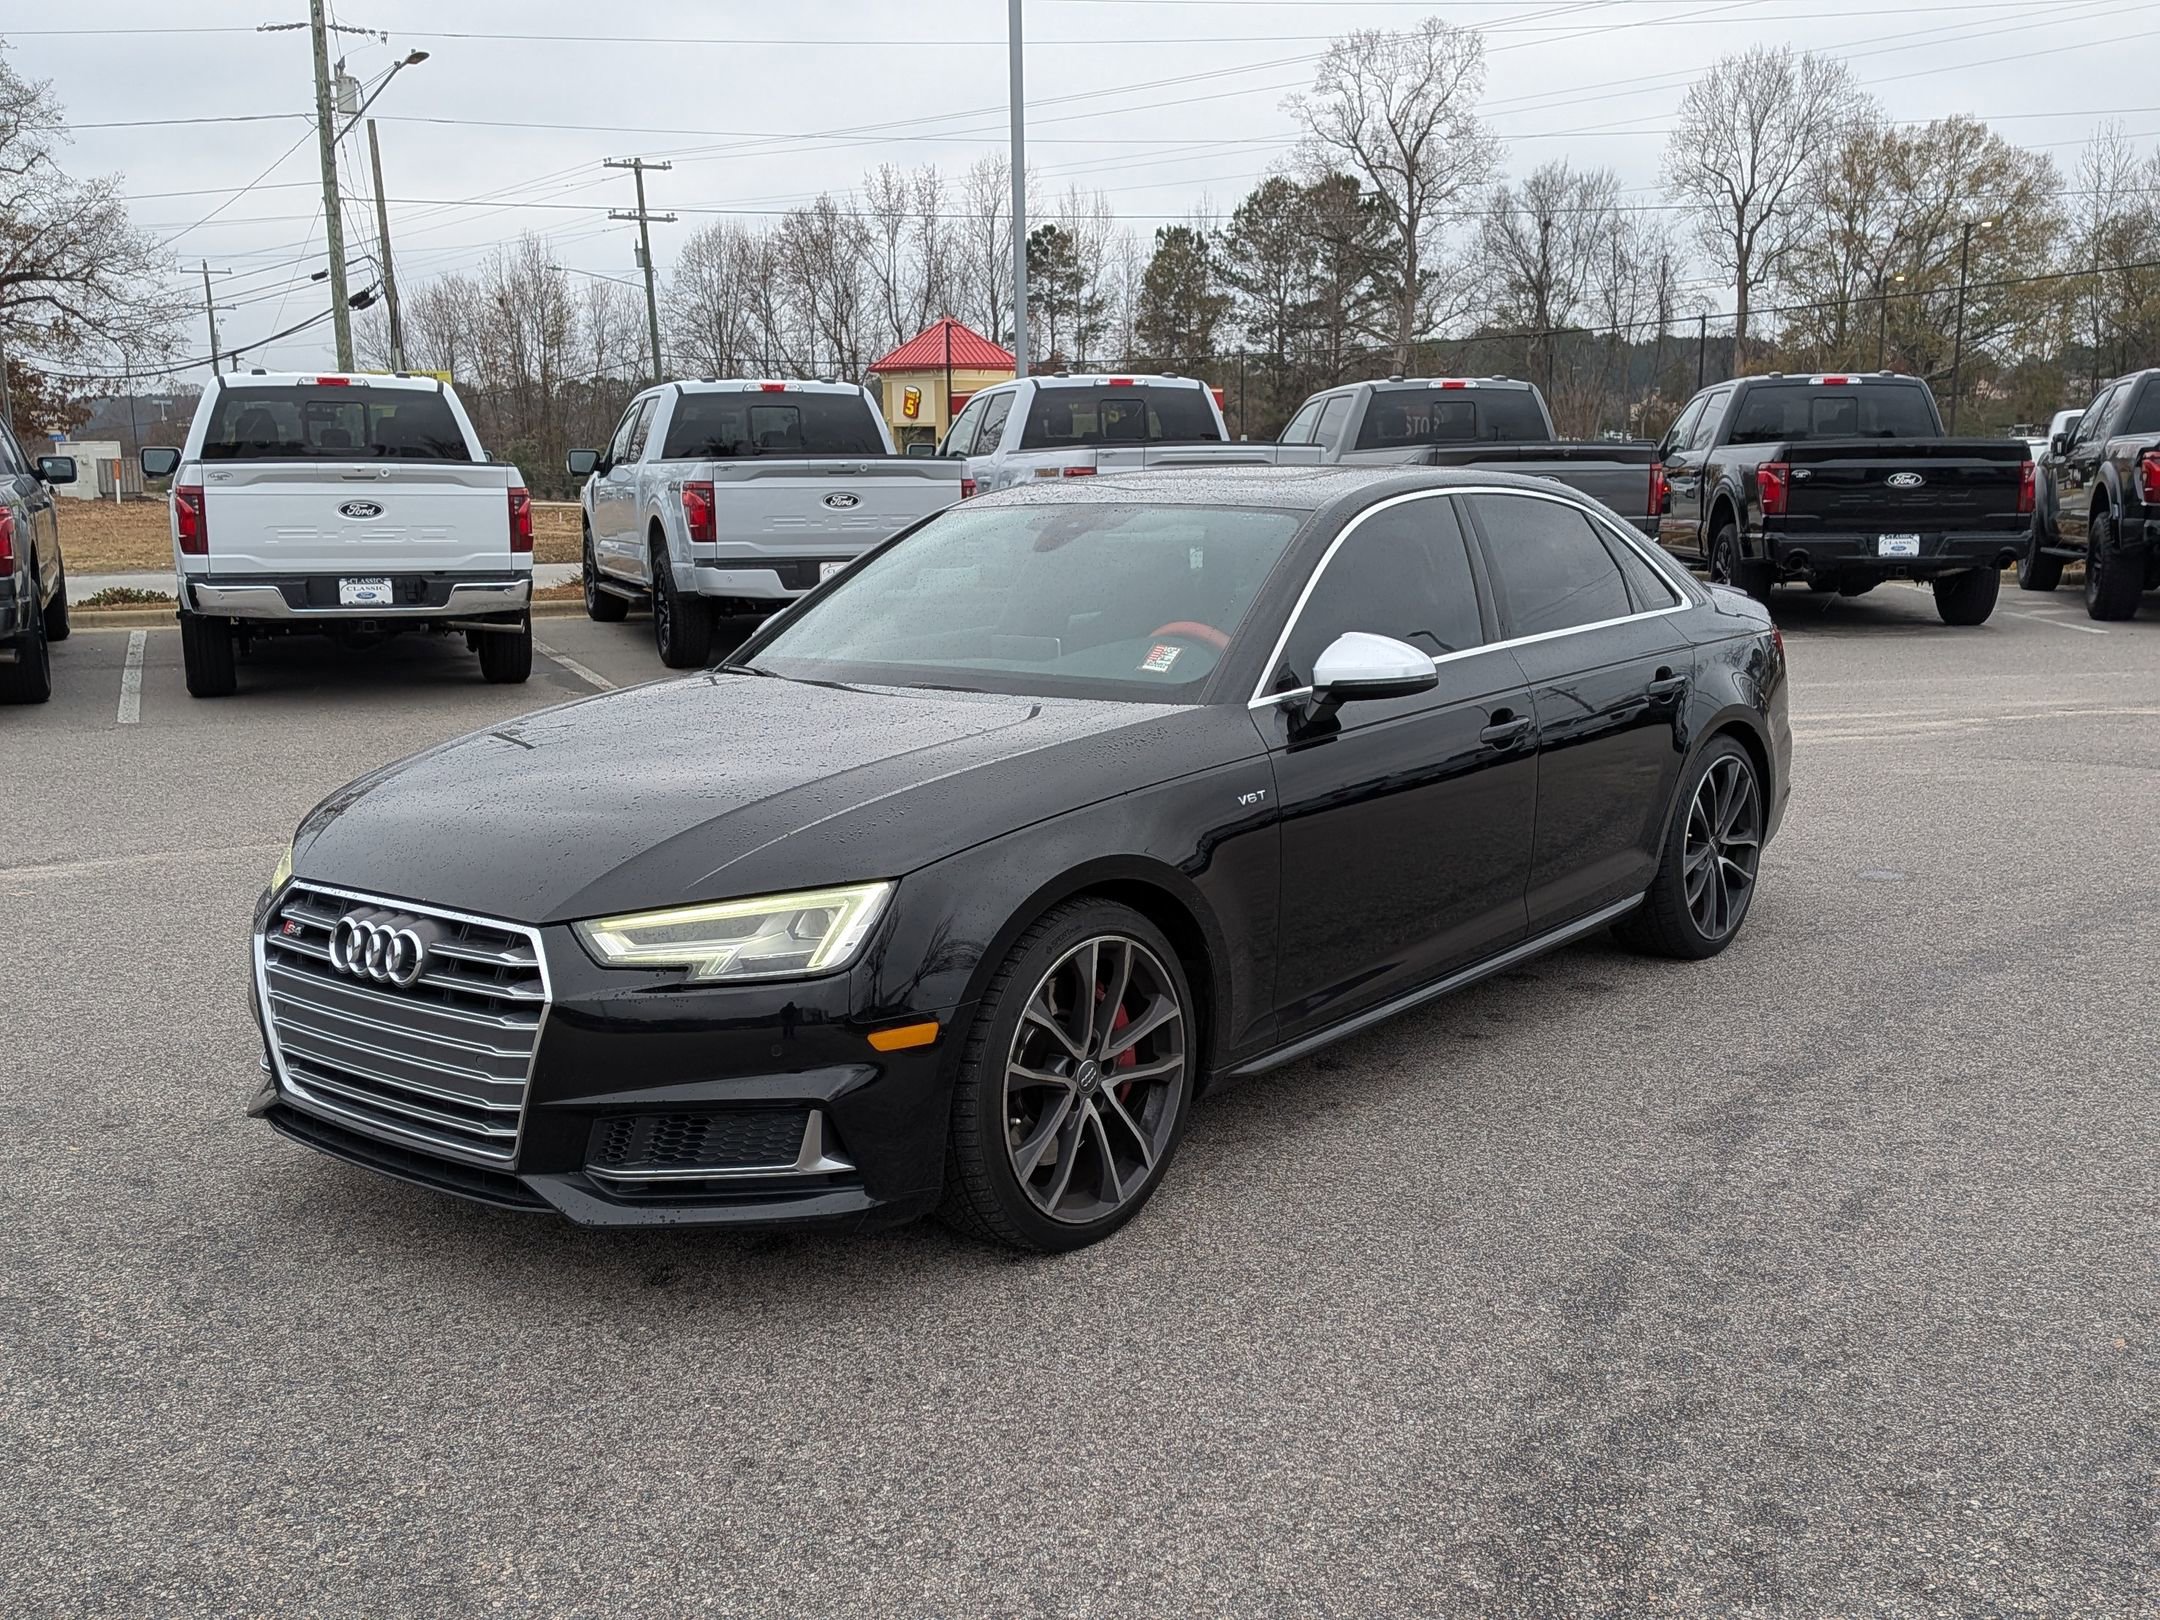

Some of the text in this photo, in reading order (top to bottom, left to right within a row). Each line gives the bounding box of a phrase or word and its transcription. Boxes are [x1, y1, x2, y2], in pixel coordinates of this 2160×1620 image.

[905, 399, 914, 415] 5
[264, 525, 459, 544] F-150
[1237, 789, 1266, 806] V6T
[286, 923, 302, 936] S4
